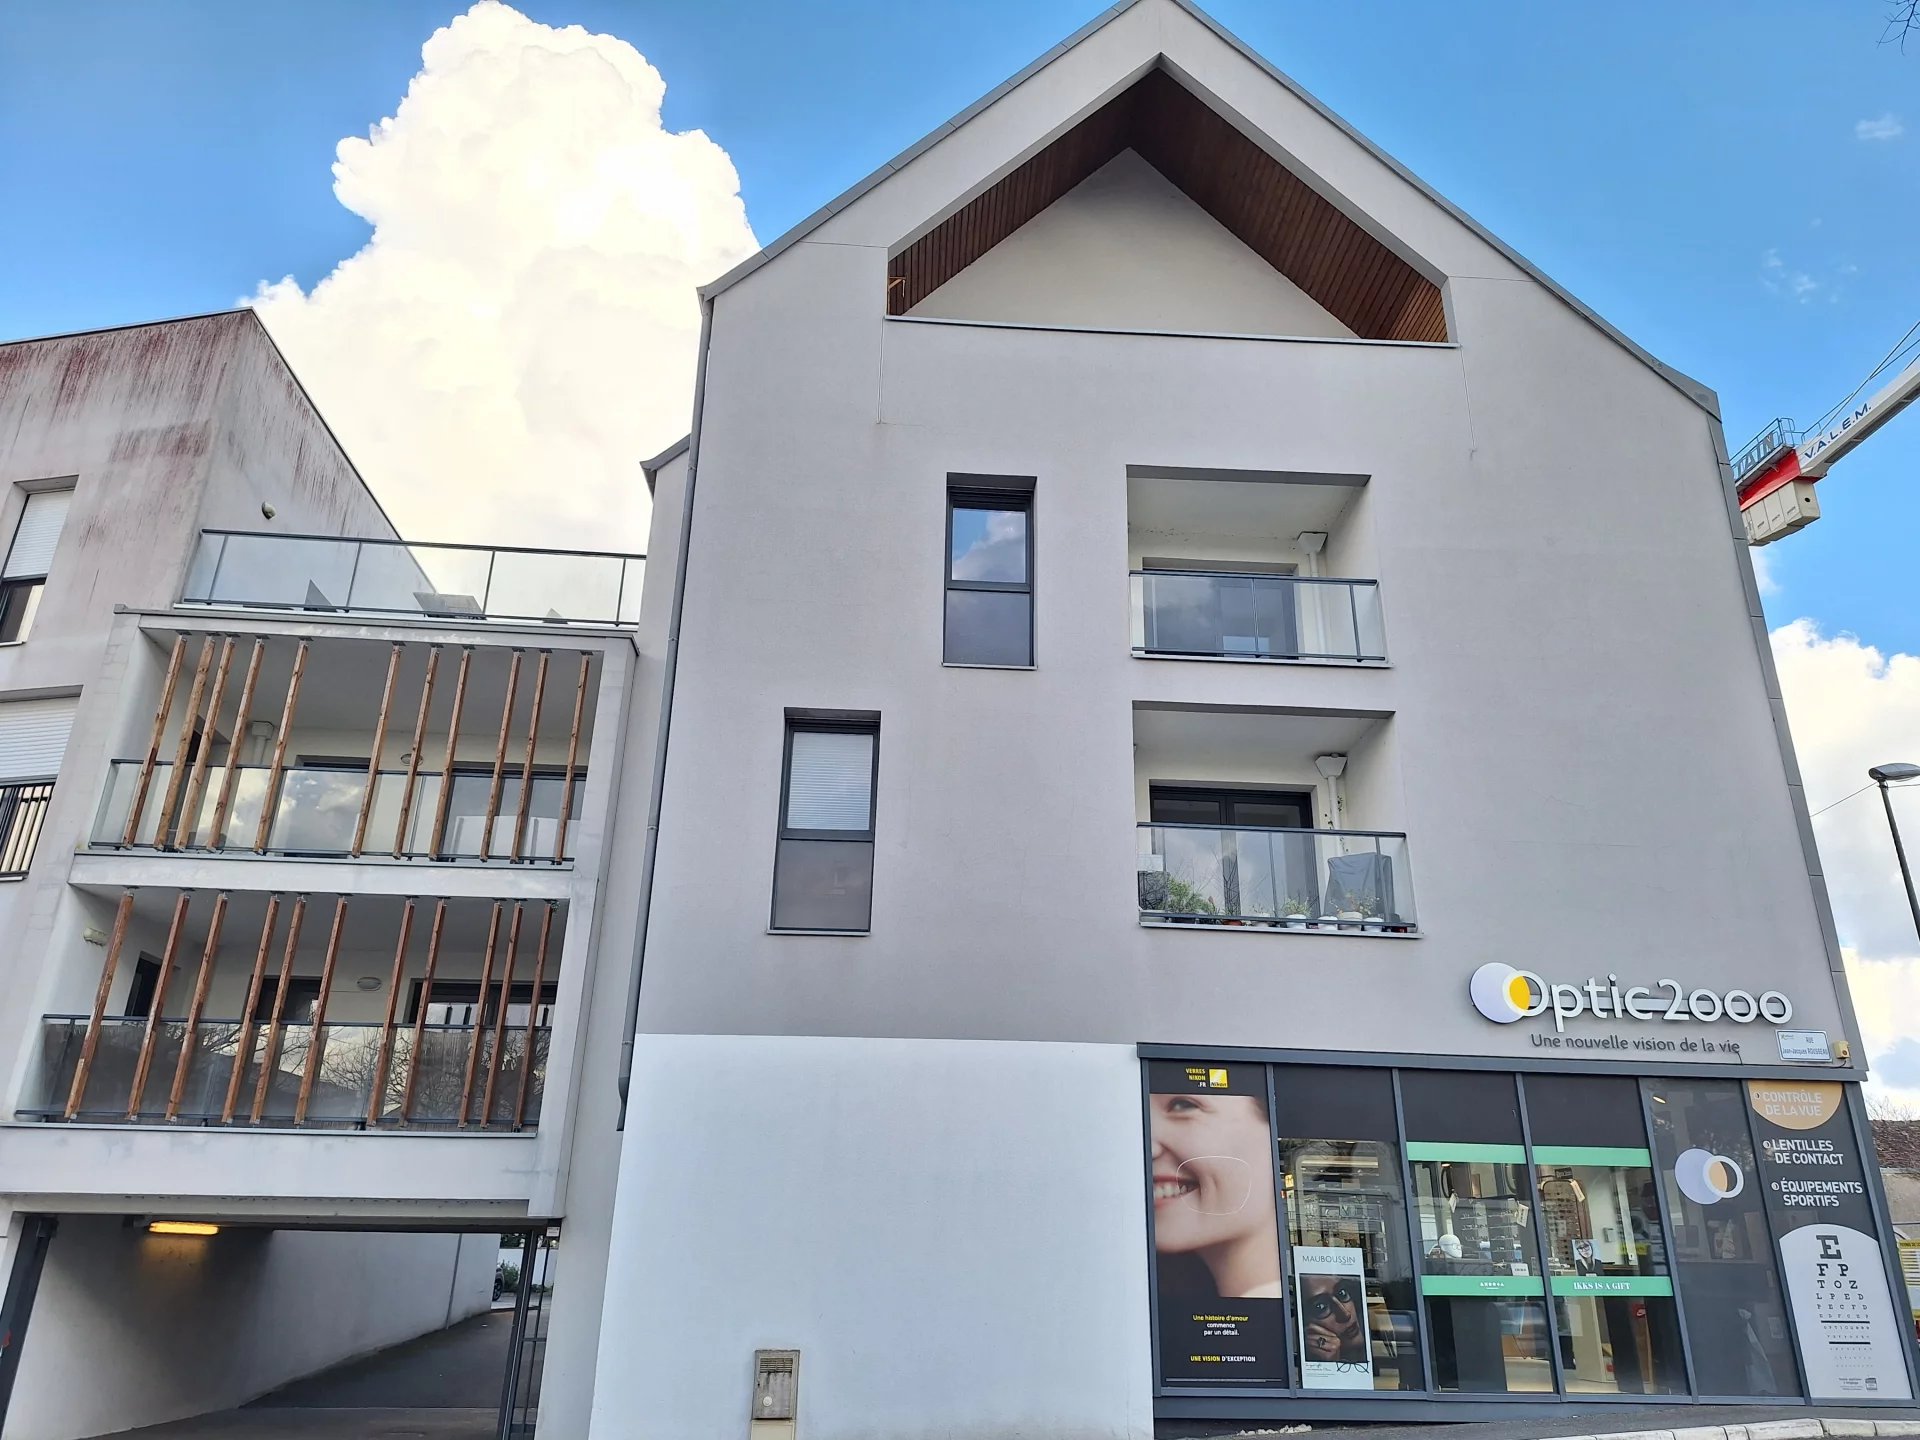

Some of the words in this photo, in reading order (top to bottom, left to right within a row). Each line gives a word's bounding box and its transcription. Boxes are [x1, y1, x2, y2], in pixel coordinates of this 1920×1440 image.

[1531, 1033, 1560, 1047] Une
[1565, 1034, 1628, 1050] nouvelle
[1633, 1037, 1675, 1051] vision
[1680, 1037, 1698, 1052] de
[1701, 1037, 1715, 1052] la
[1719, 1039, 1740, 1053] vie
[1762, 1090, 1822, 1103] CONTRÔLE
[1765, 1104, 1781, 1115] DE
[1783, 1105, 1797, 1116] LA
[1798, 1106, 1822, 1116] VUE
[1772, 1139, 1834, 1151] LENTILLES
[1775, 1152, 1791, 1164] DE
[1793, 1153, 1844, 1165] CONTACT
[1780, 1177, 1863, 1194] ÉQUIPEMENTS
[1783, 1194, 1840, 1207] SPORTIFS
[1816, 1234, 1842, 1259] E
[1302, 1255, 1356, 1264] MAUBOUSSIN
